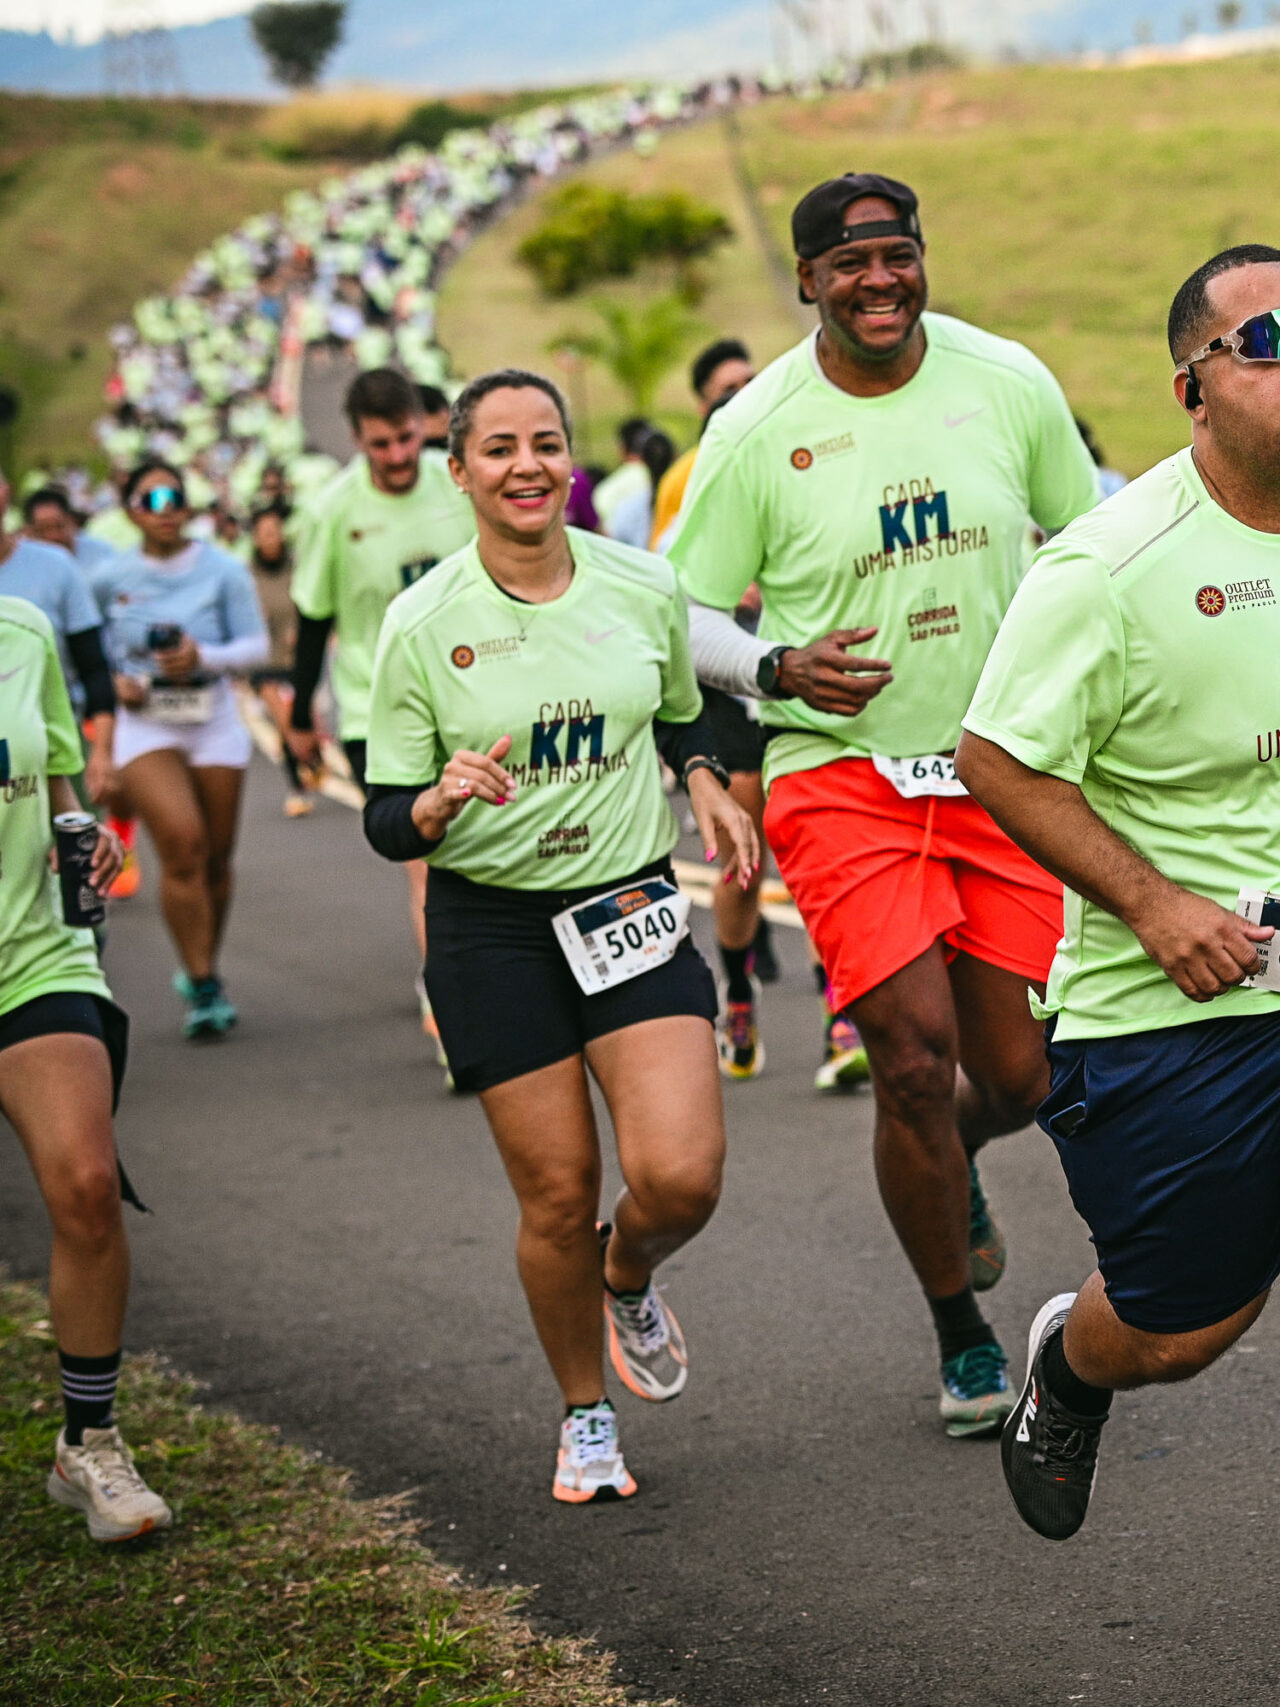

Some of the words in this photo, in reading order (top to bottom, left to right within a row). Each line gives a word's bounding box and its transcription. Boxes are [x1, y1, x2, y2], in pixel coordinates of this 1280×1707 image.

[883, 476, 936, 511] CADA
[879, 490, 950, 555] KM
[853, 551, 896, 579] UMA
[529, 714, 606, 770] KM
[605, 906, 677, 960] 5040
[1015, 1375, 1040, 1442] FILA
